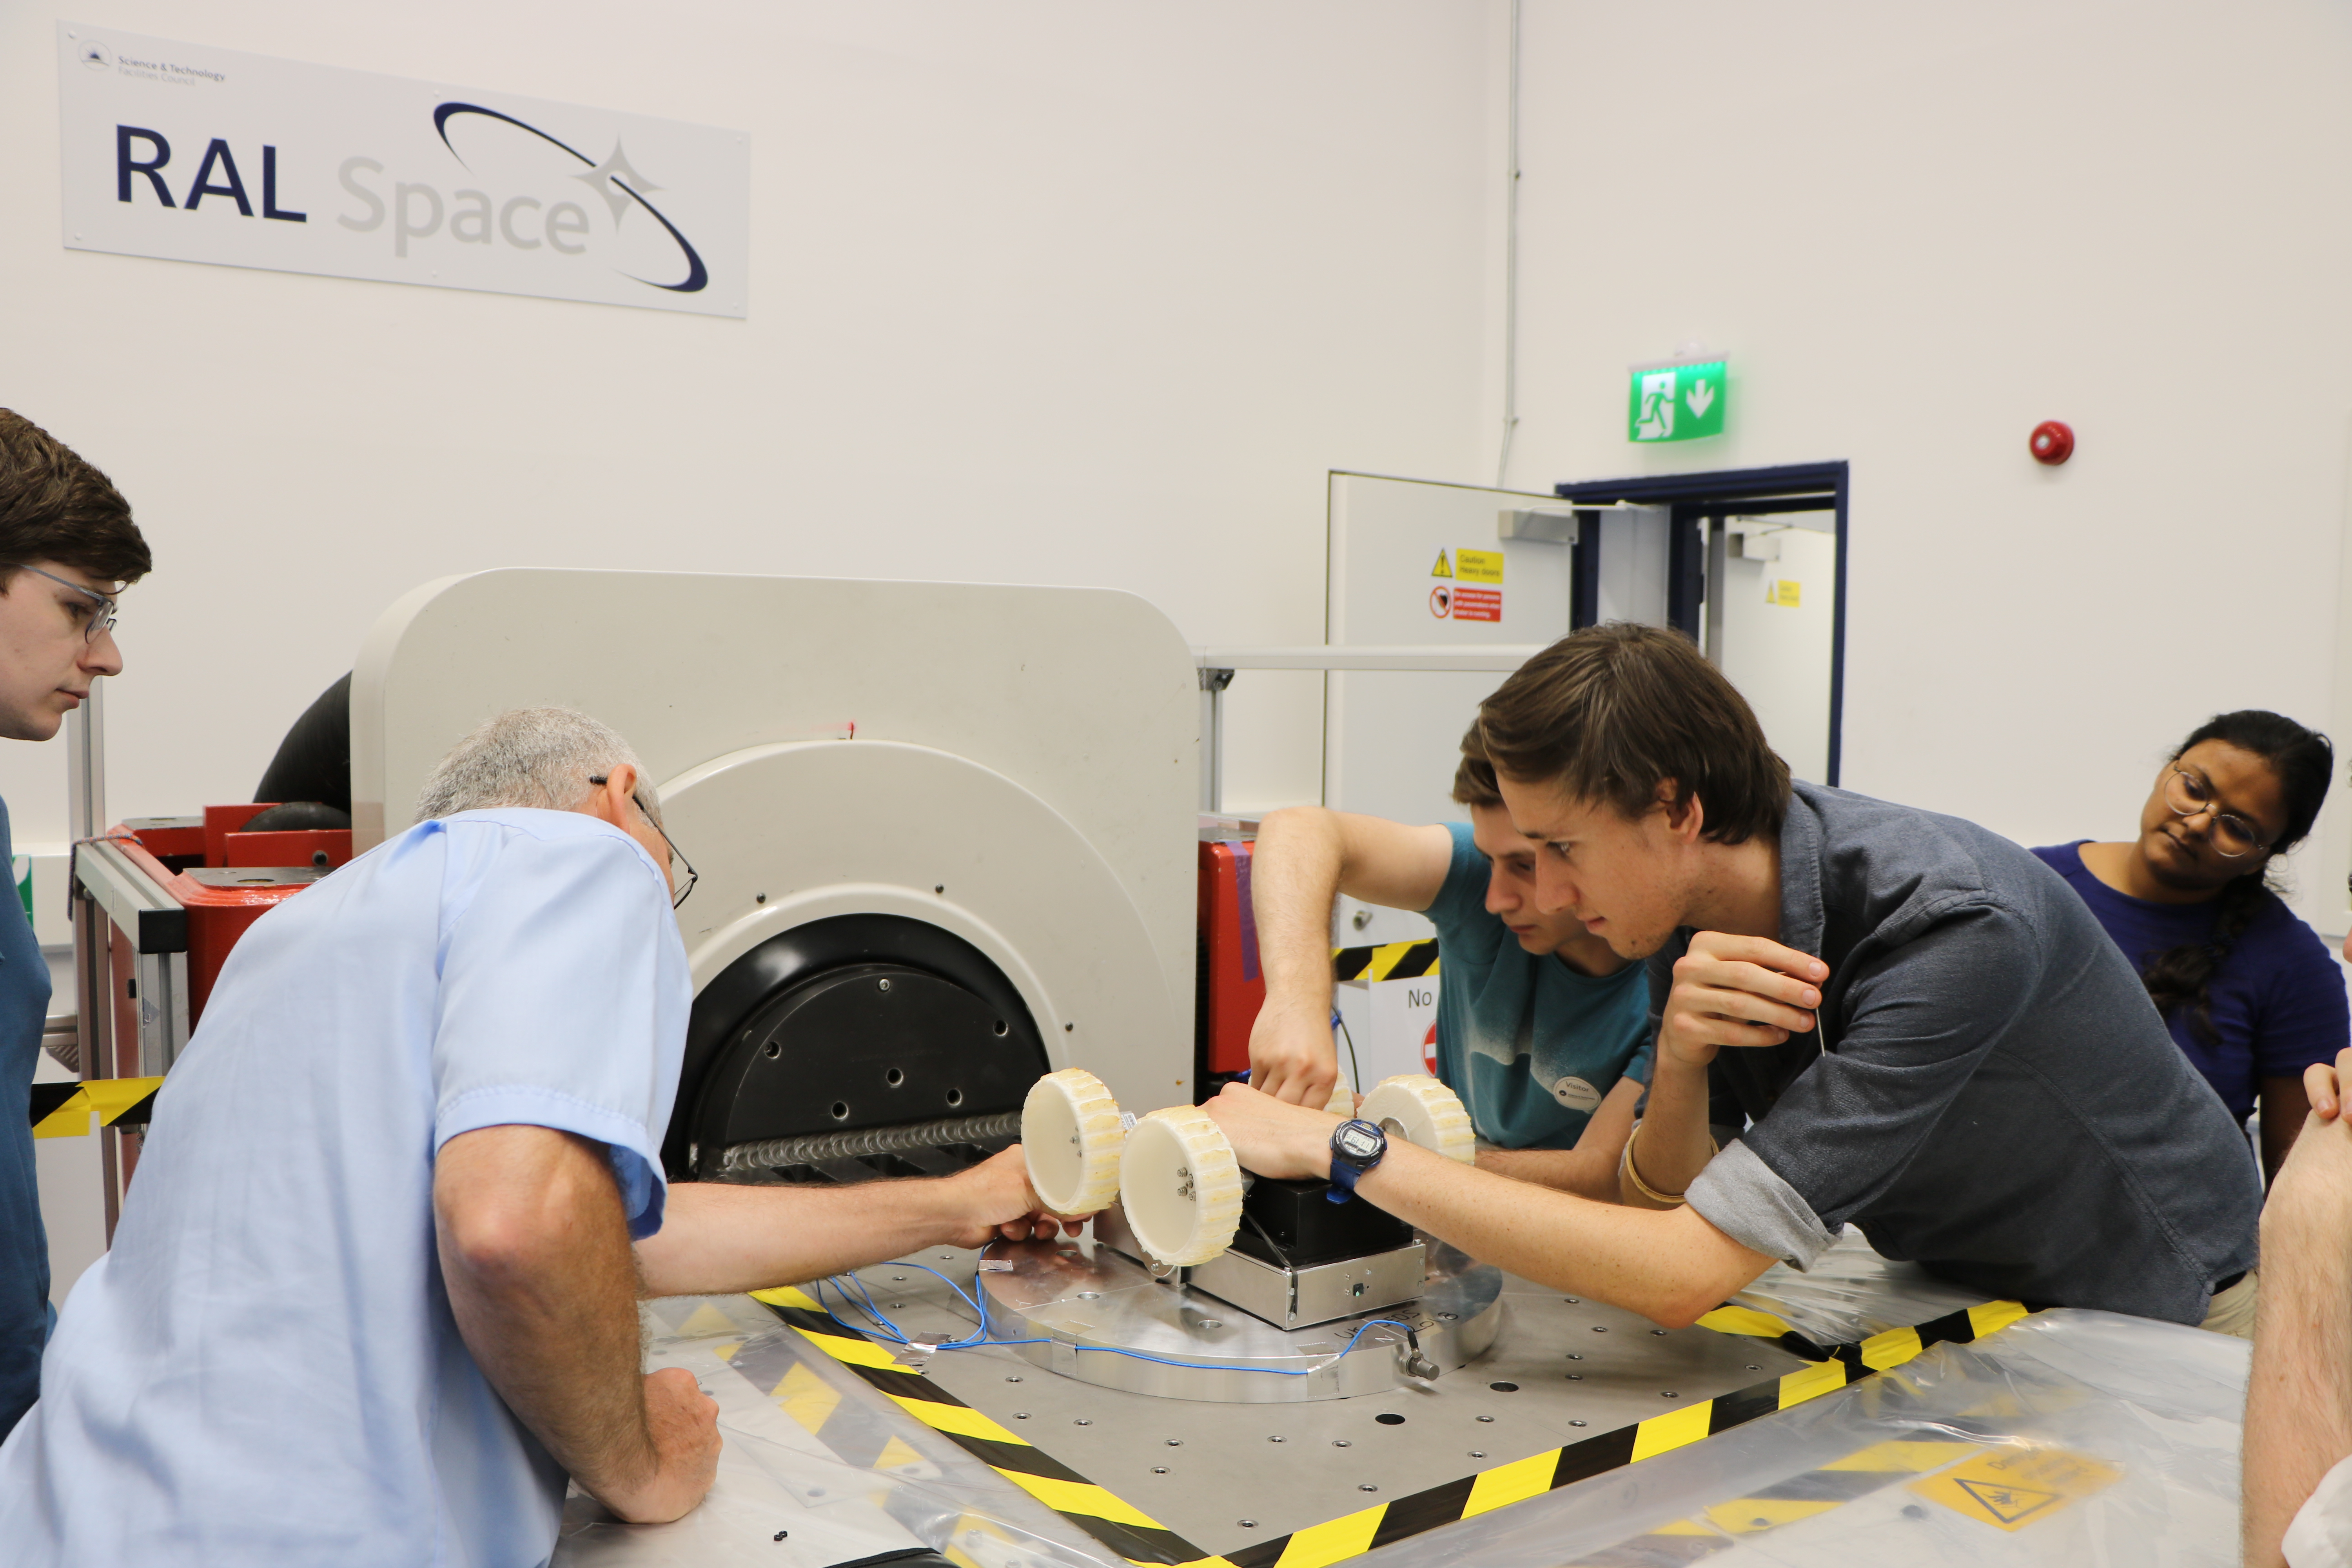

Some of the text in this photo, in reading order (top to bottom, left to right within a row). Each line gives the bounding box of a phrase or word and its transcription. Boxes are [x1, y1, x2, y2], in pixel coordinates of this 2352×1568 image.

[118, 56, 225, 82] Science & Technology
[119, 66, 195, 85] Facilities Council
[116, 124, 589, 258] RAL Space
[1460, 554, 1485, 564] Caution
[1460, 566, 1500, 577] Heavy doors
[1409, 989, 1432, 1008] No
[1565, 1081, 1590, 1092] Visitor
